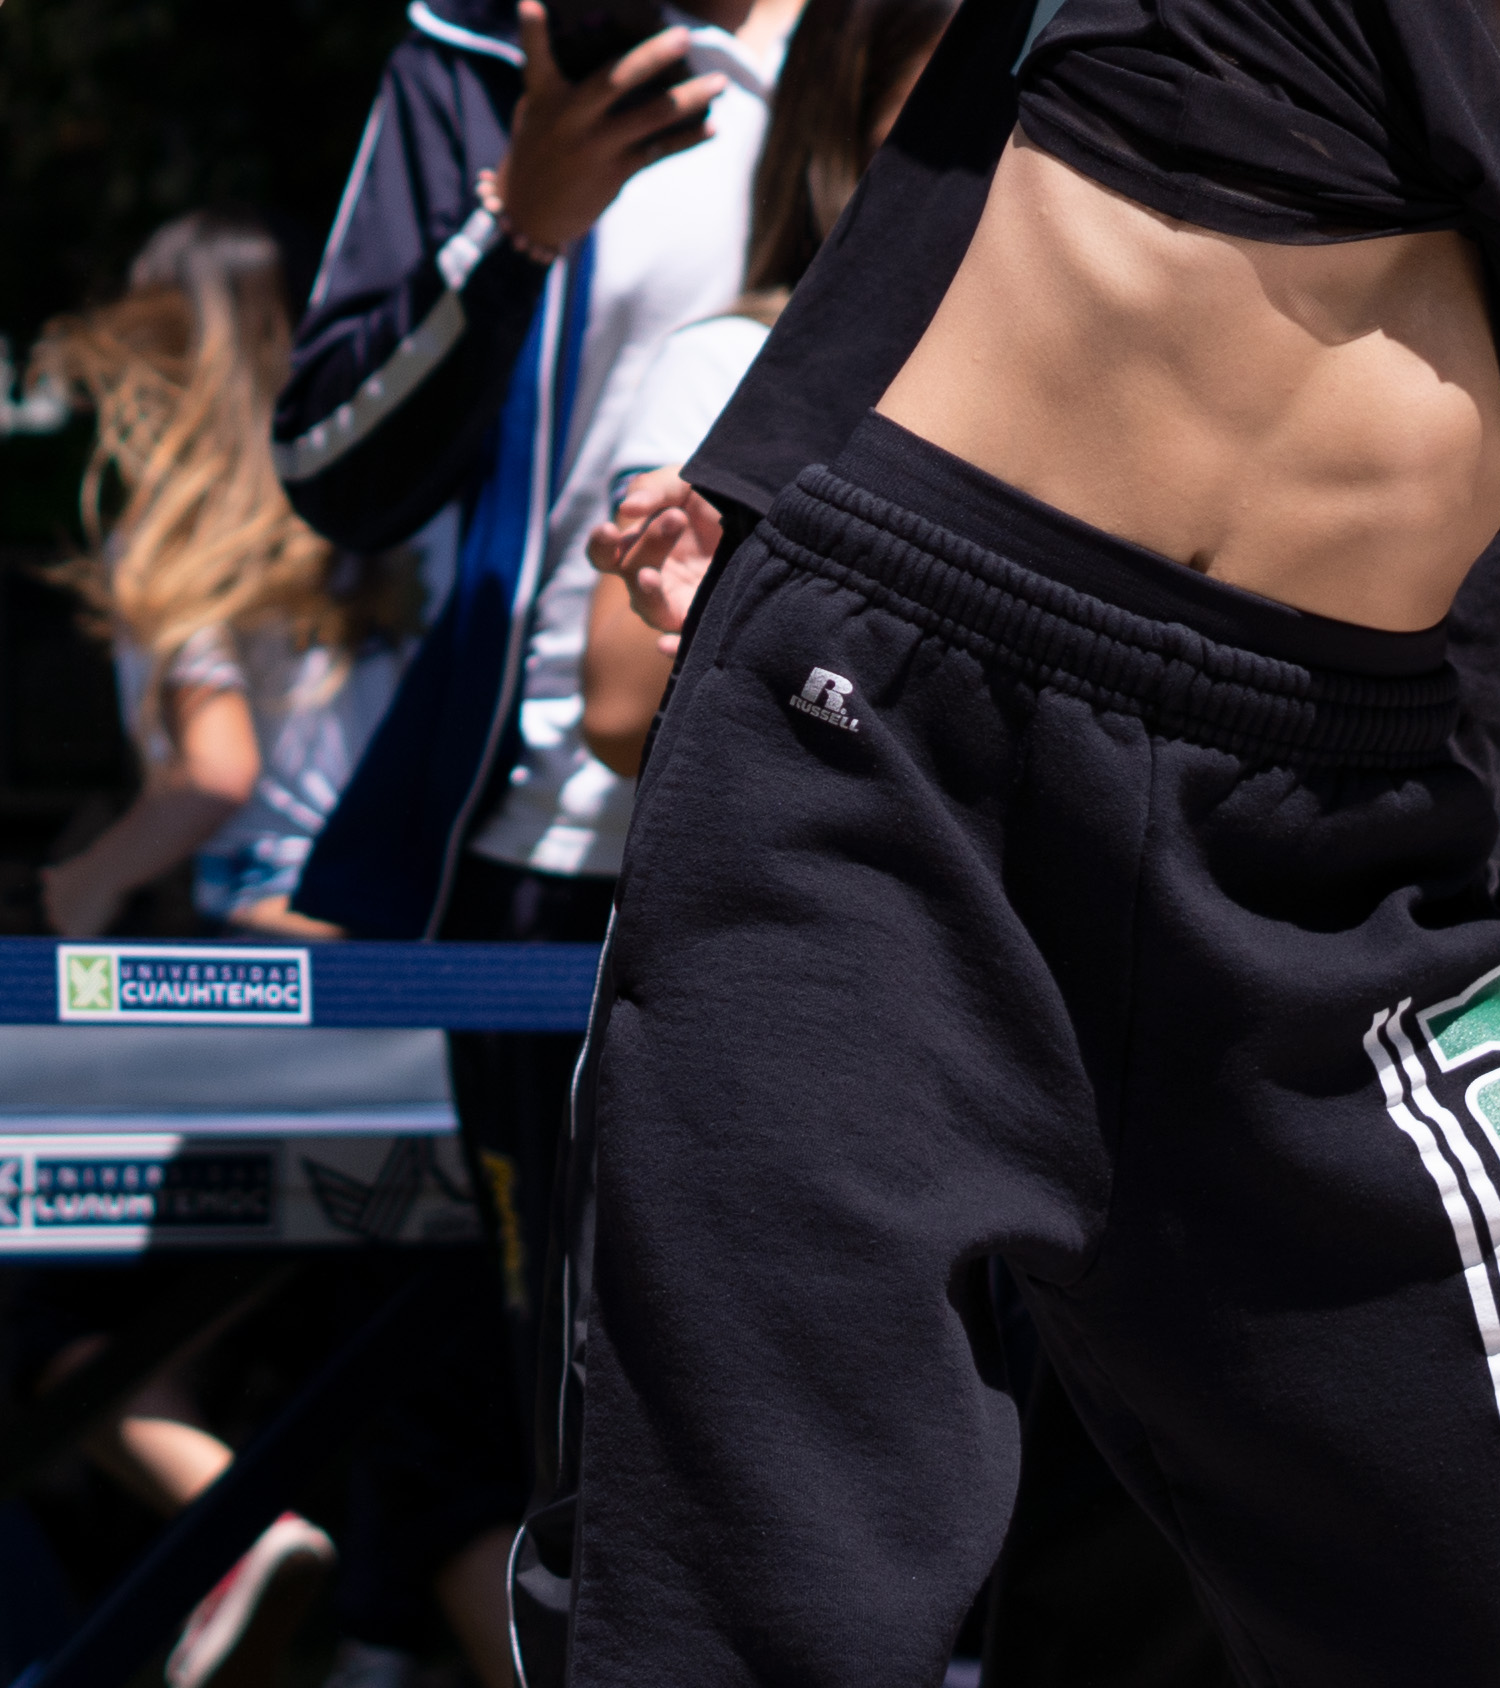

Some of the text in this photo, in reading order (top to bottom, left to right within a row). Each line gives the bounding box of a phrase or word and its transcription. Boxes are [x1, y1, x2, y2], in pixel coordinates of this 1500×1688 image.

[789, 694, 860, 733] RUSSELL
[120, 964, 300, 981] UNIVERSIDAD
[120, 981, 300, 1005] CUAUHTEMOC
